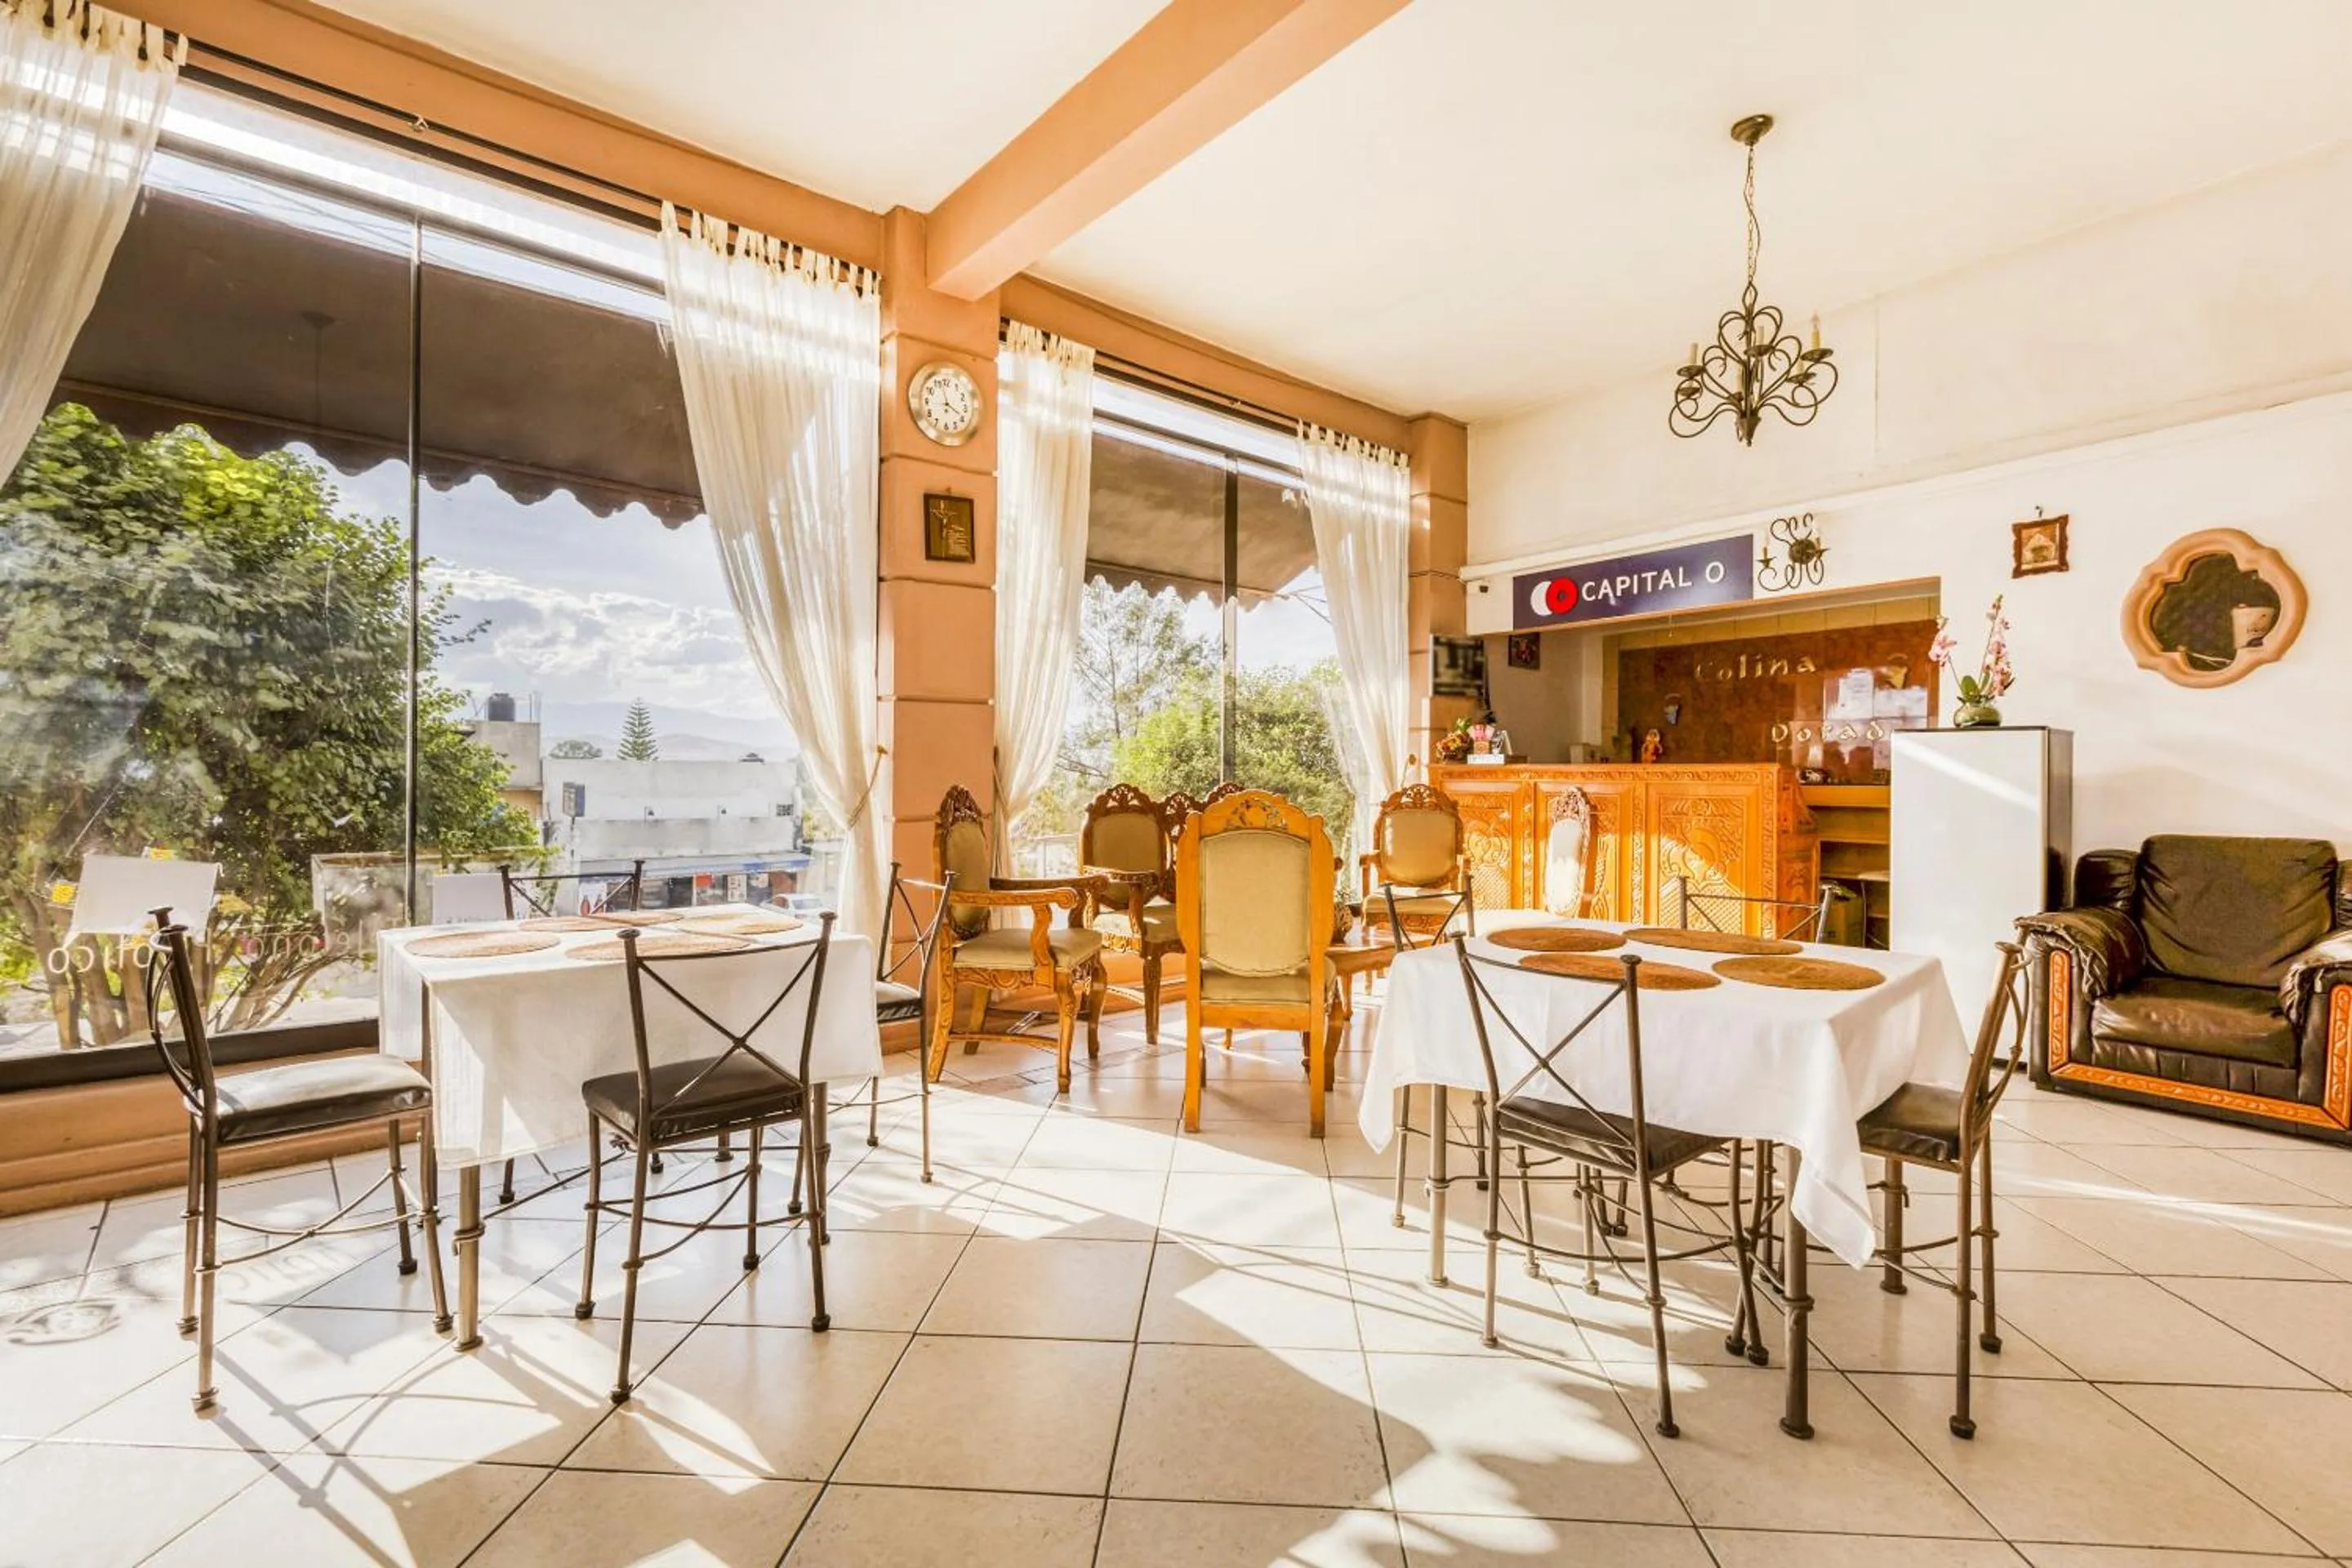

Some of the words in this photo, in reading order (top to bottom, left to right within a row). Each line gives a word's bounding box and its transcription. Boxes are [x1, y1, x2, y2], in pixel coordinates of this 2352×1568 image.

[1581, 565, 1693, 603] CAPITAL
[1704, 561, 1726, 585] O
[1771, 719, 1886, 744] Dorad
